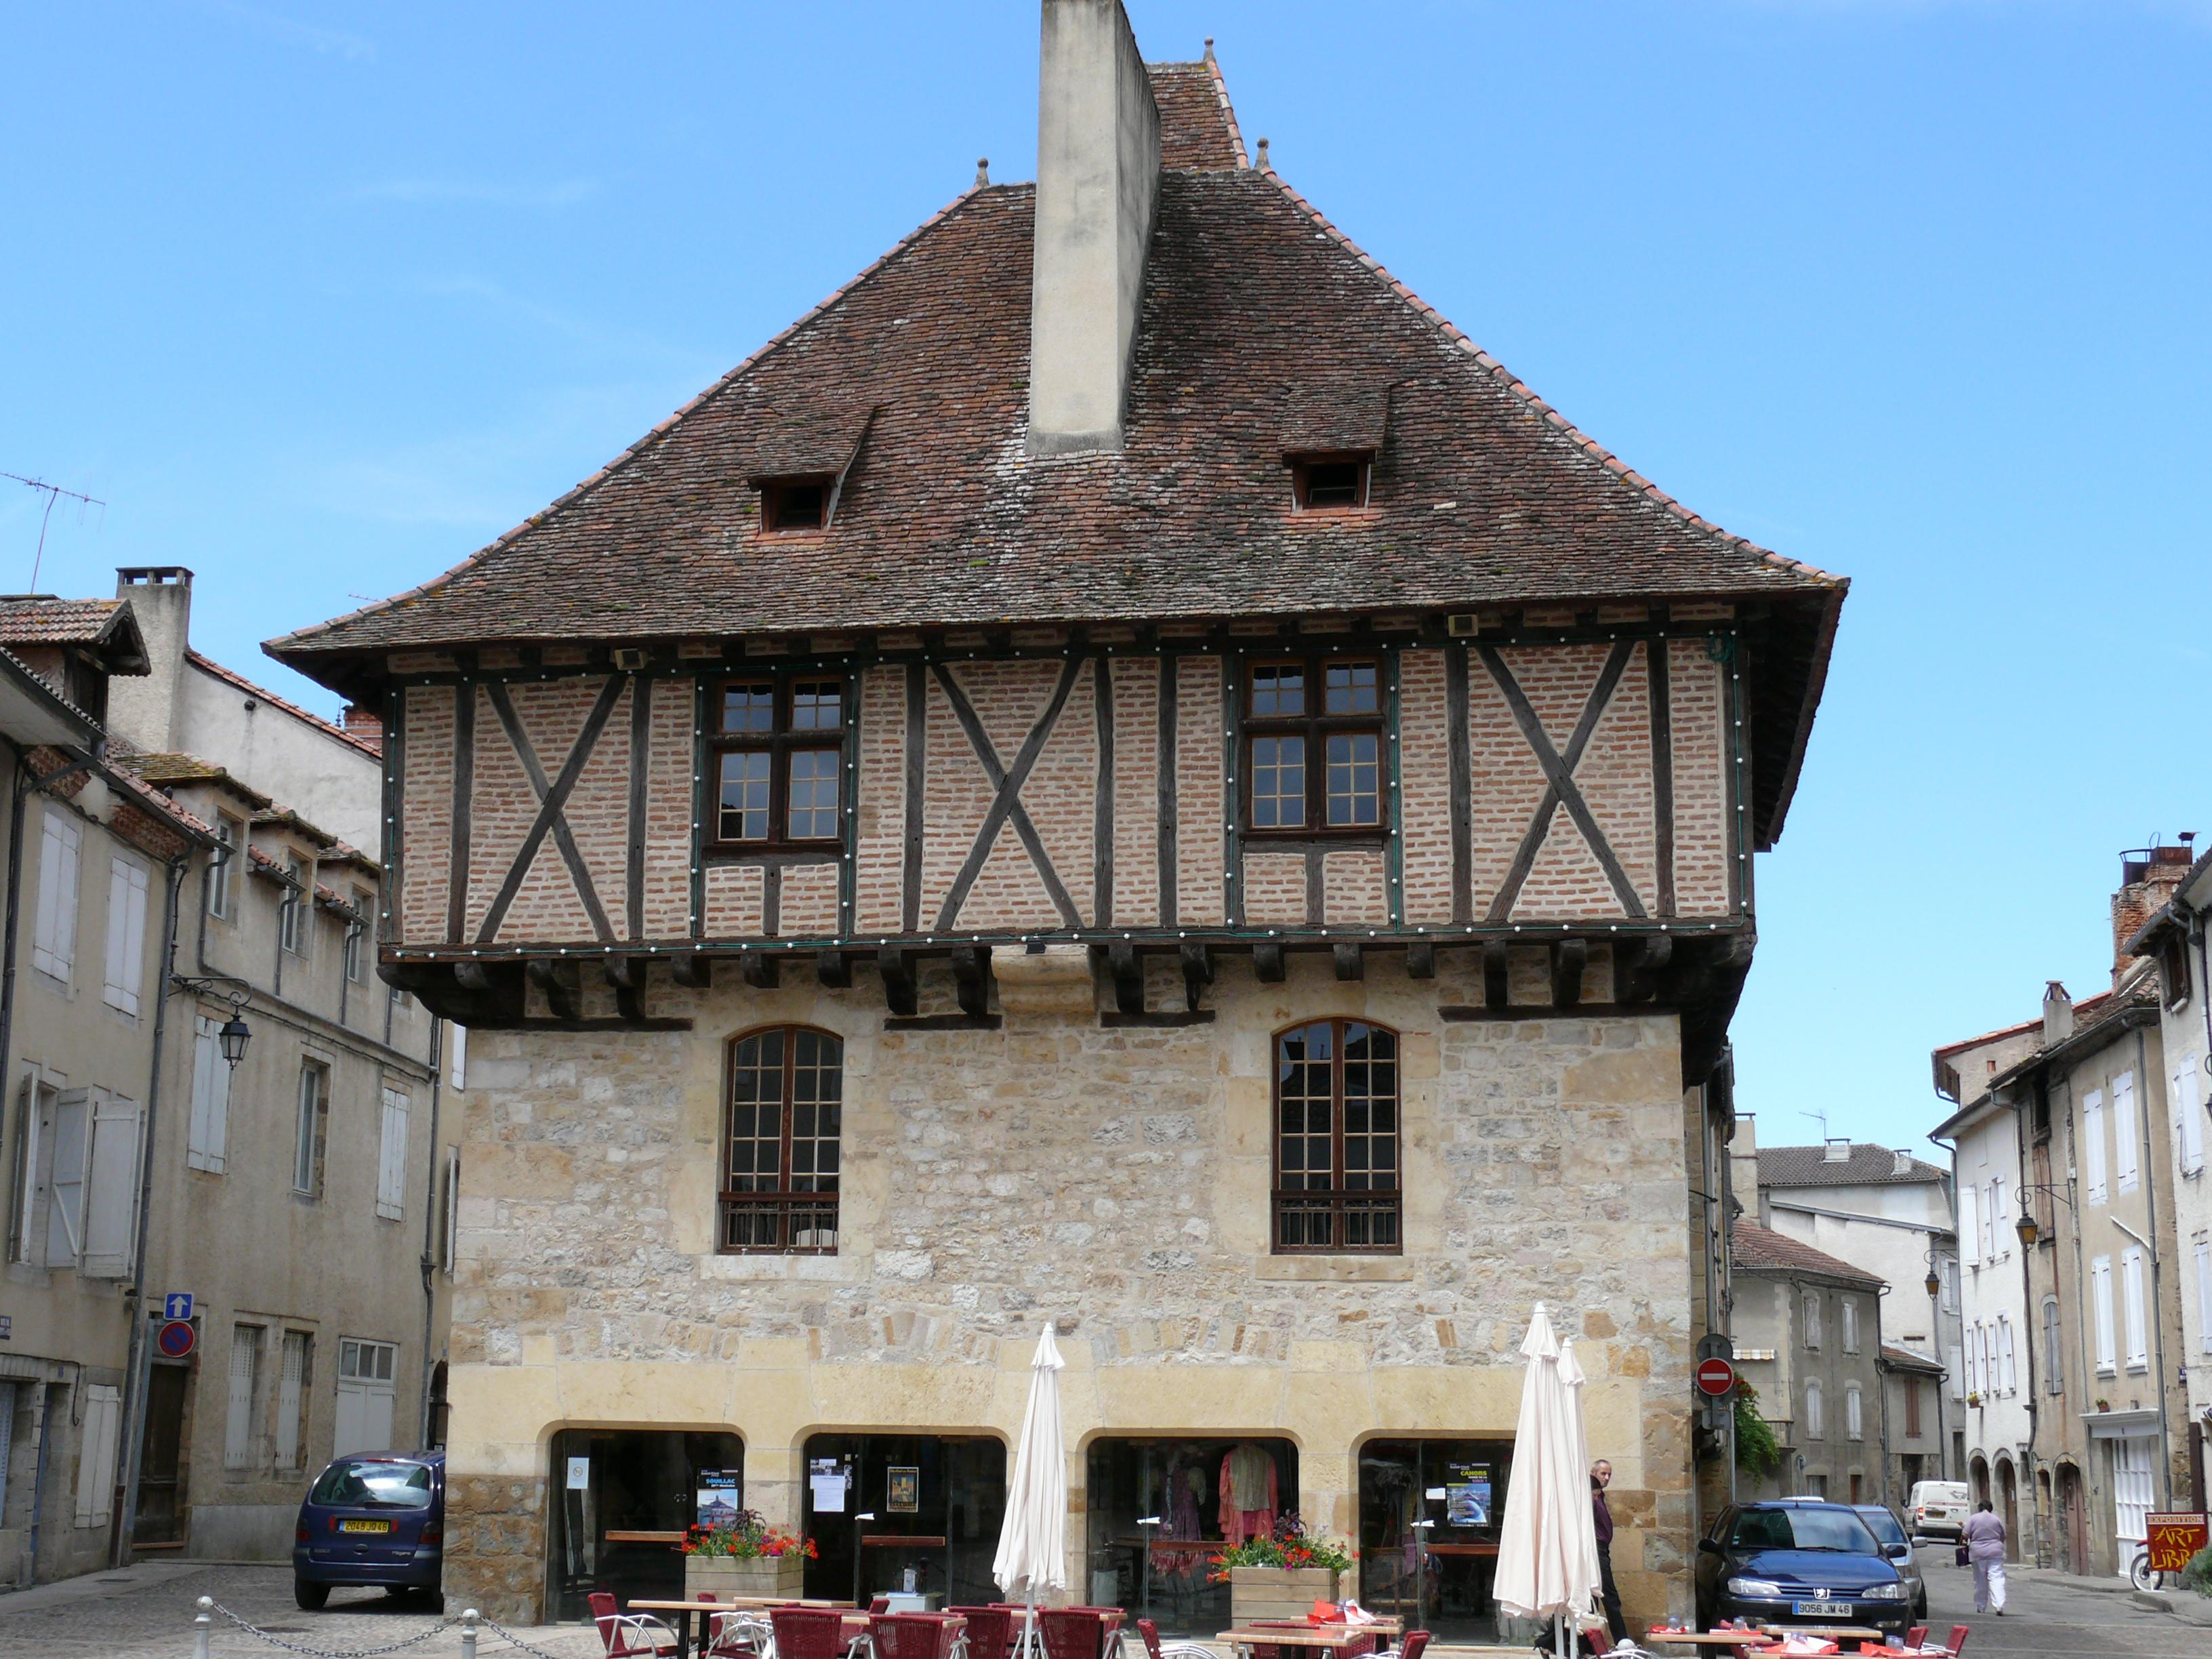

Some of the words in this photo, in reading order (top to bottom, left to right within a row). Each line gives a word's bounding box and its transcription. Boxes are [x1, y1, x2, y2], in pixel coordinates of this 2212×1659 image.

[346, 1521, 365, 1530] 2048
[377, 1522, 388, 1532] 46
[2153, 1527, 2200, 1547] ART
[1799, 1603, 1822, 1613] 9056
[1824, 1604, 1836, 1614] JM
[1838, 1605, 1850, 1614] 46
